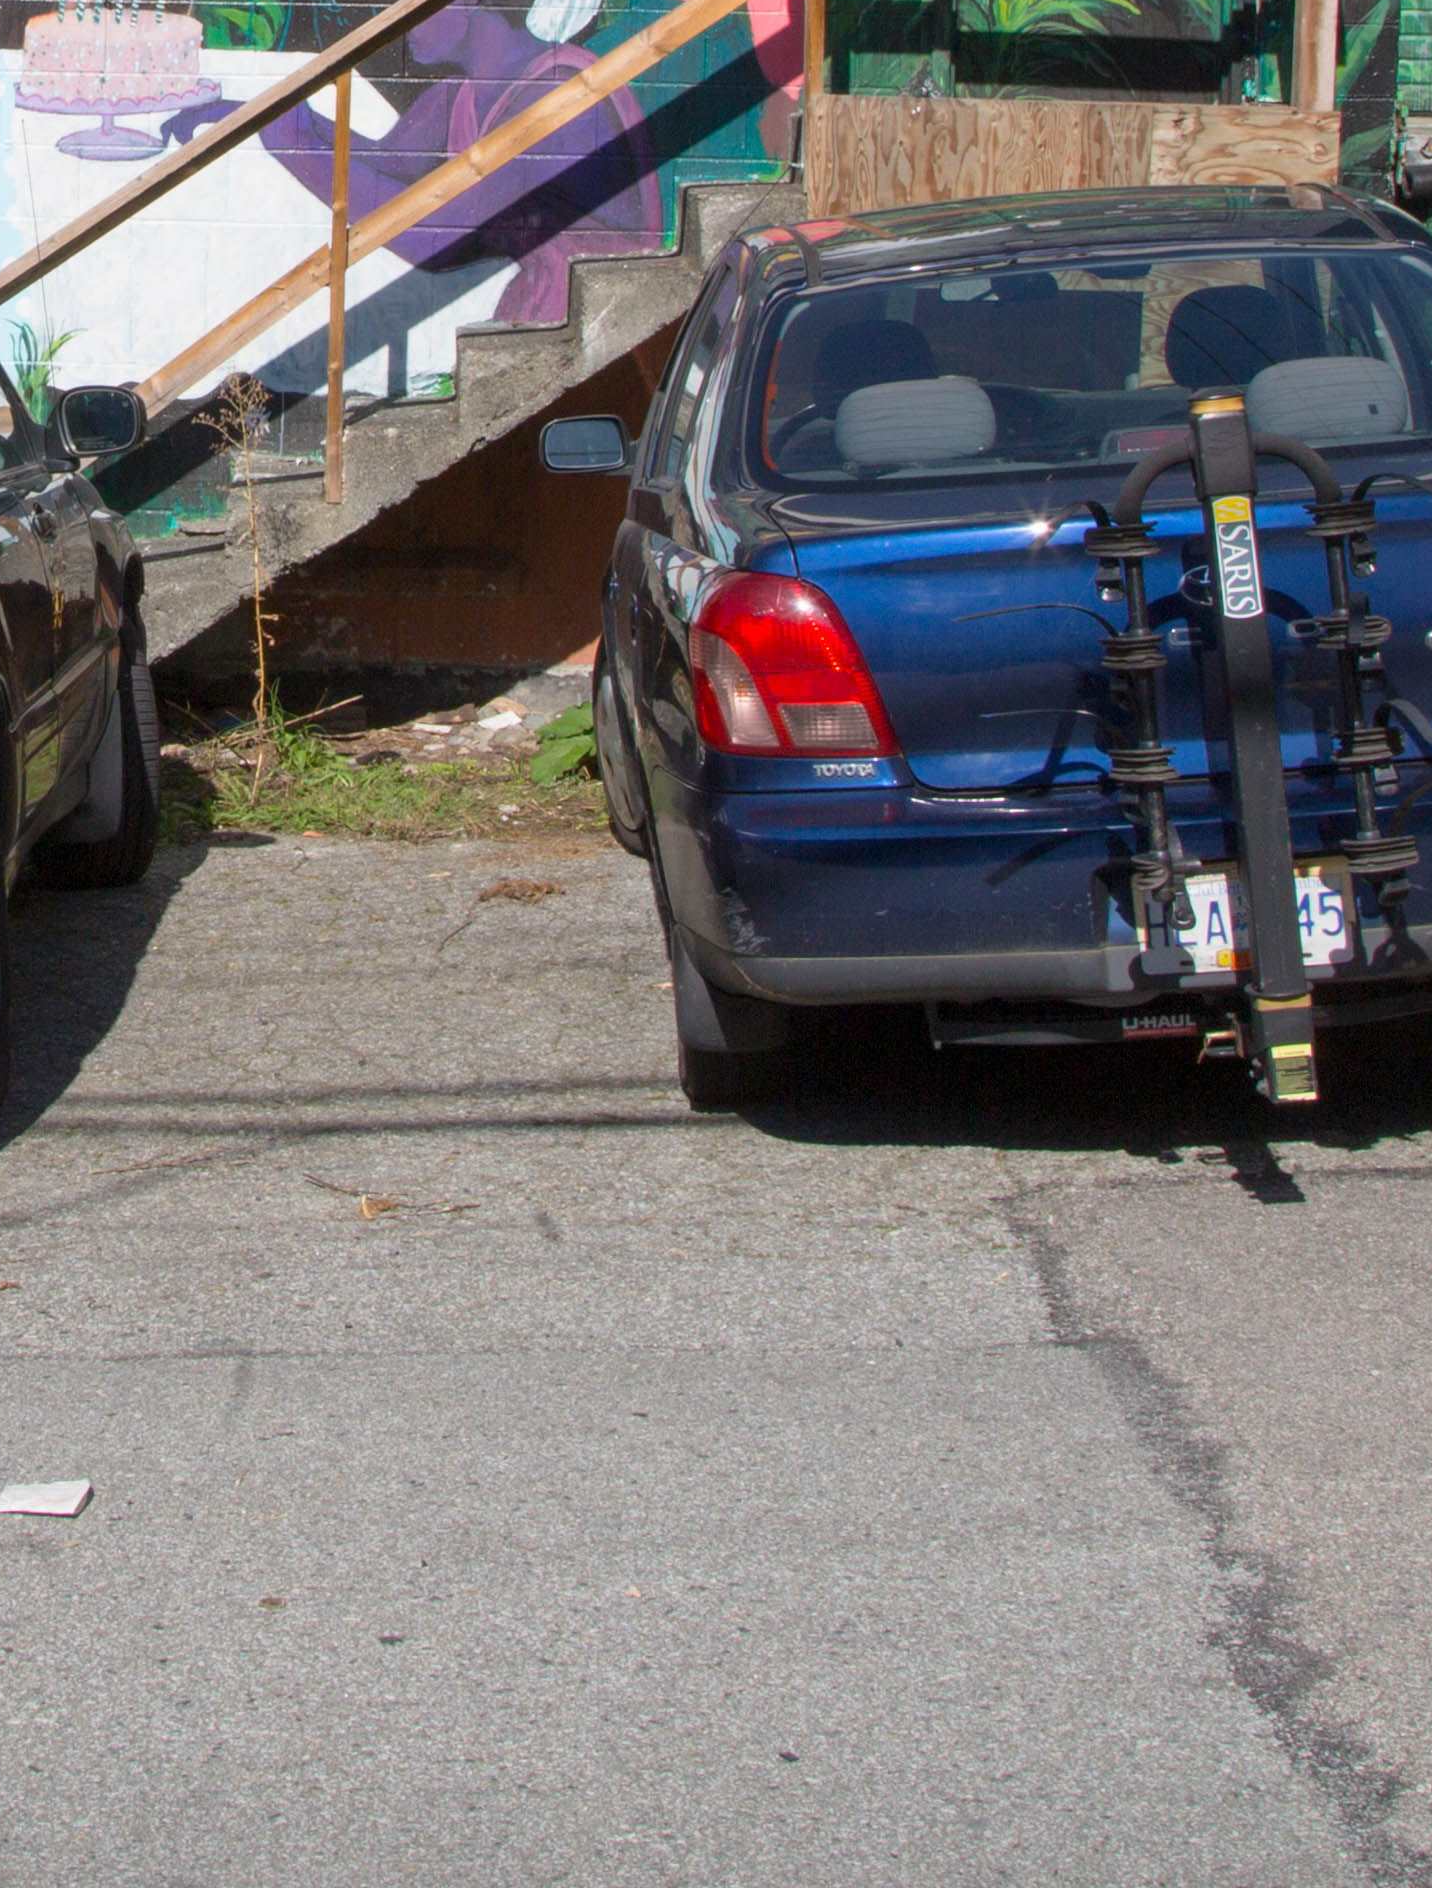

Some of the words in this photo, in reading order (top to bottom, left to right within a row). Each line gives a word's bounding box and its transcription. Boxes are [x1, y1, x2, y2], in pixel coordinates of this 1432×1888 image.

[1218, 524, 1258, 612] SARIS
[813, 763, 877, 777] TOYOTA
[1297, 889, 1345, 937] 45
[1122, 1014, 1197, 1030] U-HAUL
